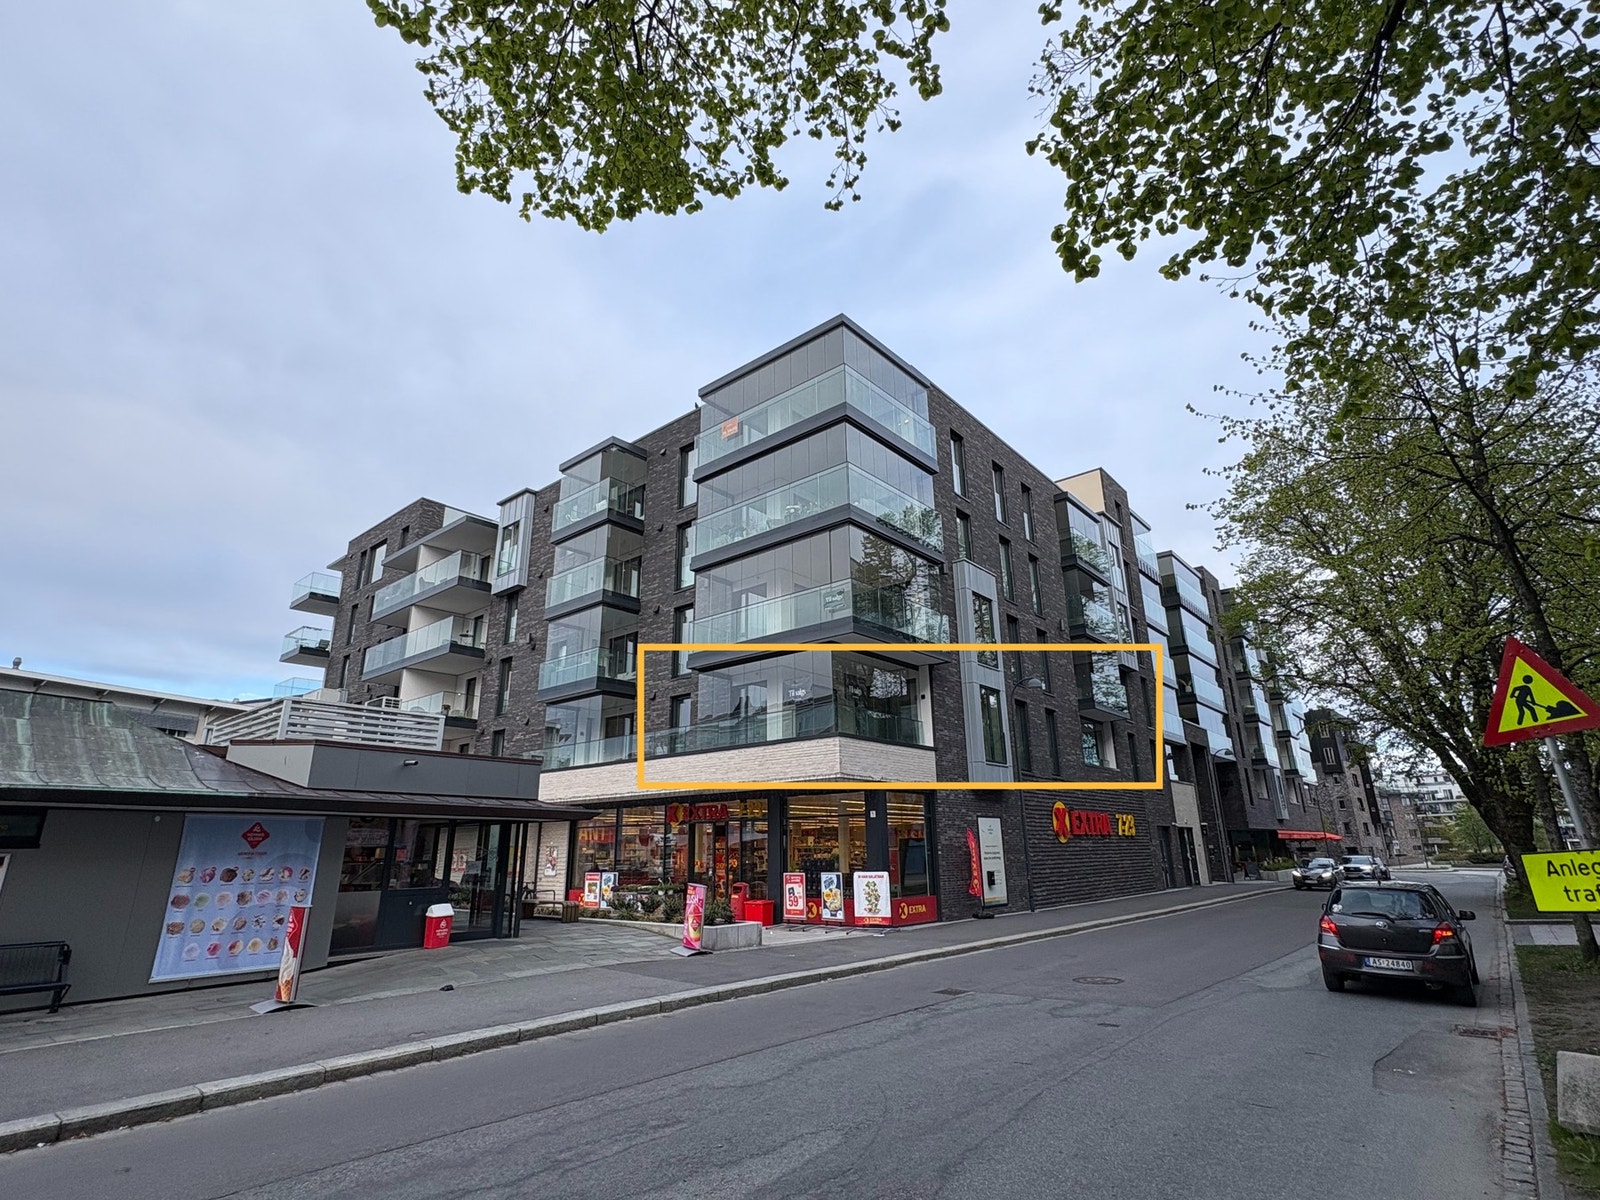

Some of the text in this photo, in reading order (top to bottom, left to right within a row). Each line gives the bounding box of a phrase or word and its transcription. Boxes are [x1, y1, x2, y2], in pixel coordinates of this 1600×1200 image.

[1071, 811, 1111, 835] EXTRA
[788, 895, 799, 907] 59
[908, 904, 927, 914] EXTRA
[1371, 958, 1411, 969] AS 24840
